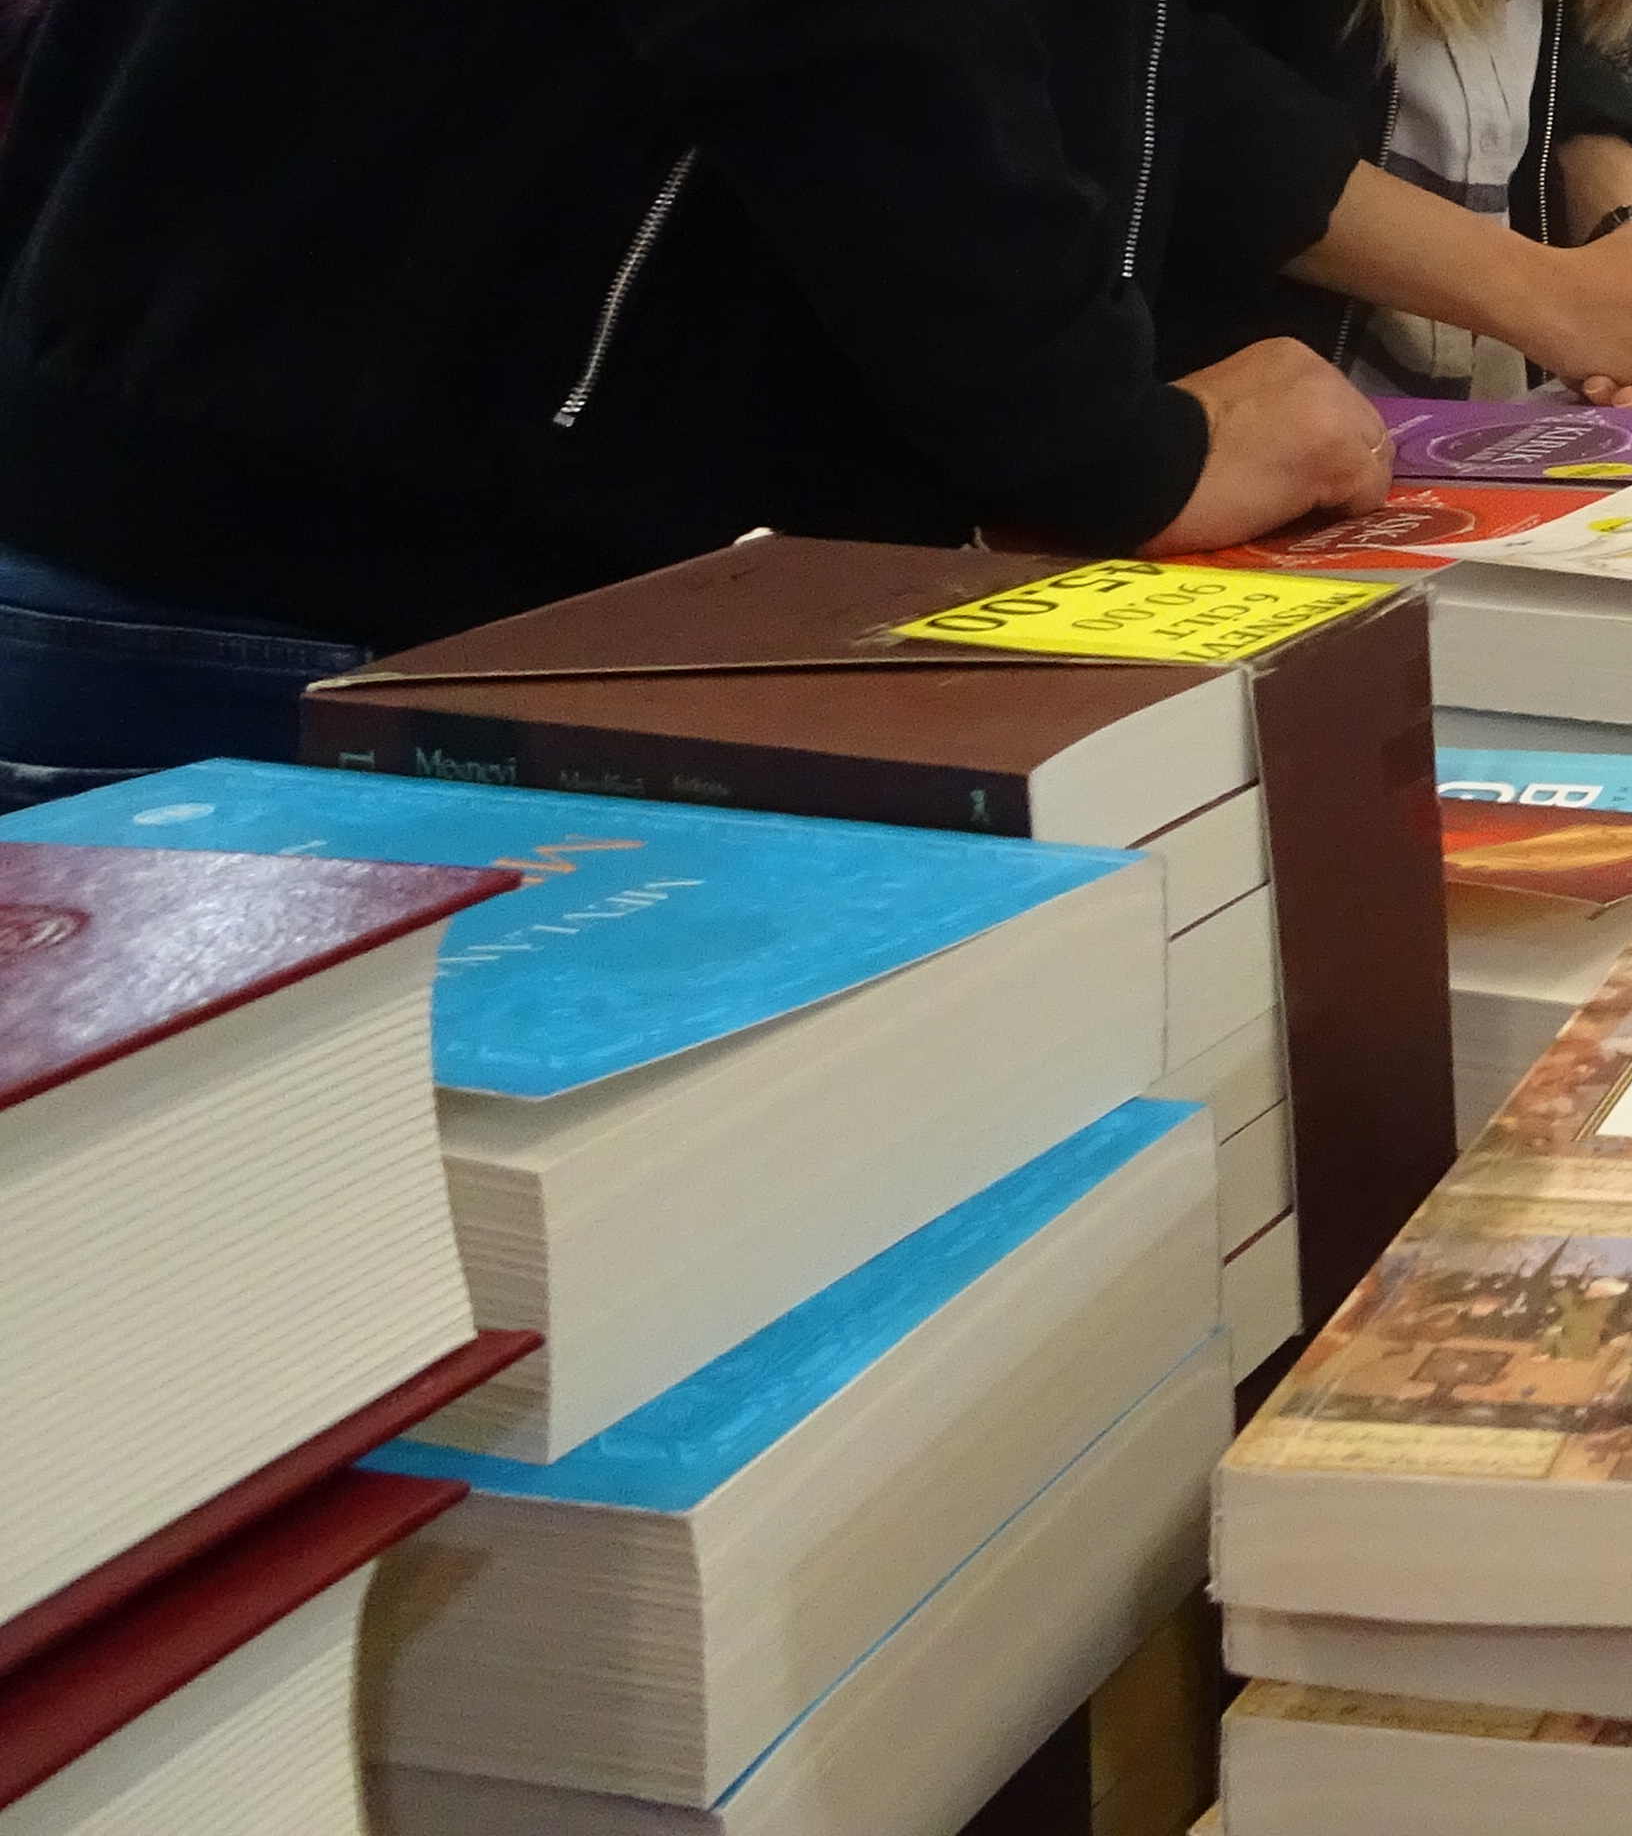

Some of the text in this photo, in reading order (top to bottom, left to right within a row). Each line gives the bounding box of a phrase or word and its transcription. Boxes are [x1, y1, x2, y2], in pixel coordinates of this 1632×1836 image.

[1492, 425, 1593, 464] KIRIK
[928, 563, 1168, 633] 45.00
[1072, 582, 1227, 632] 90.00
[1154, 592, 1280, 641] 6 CİLT
